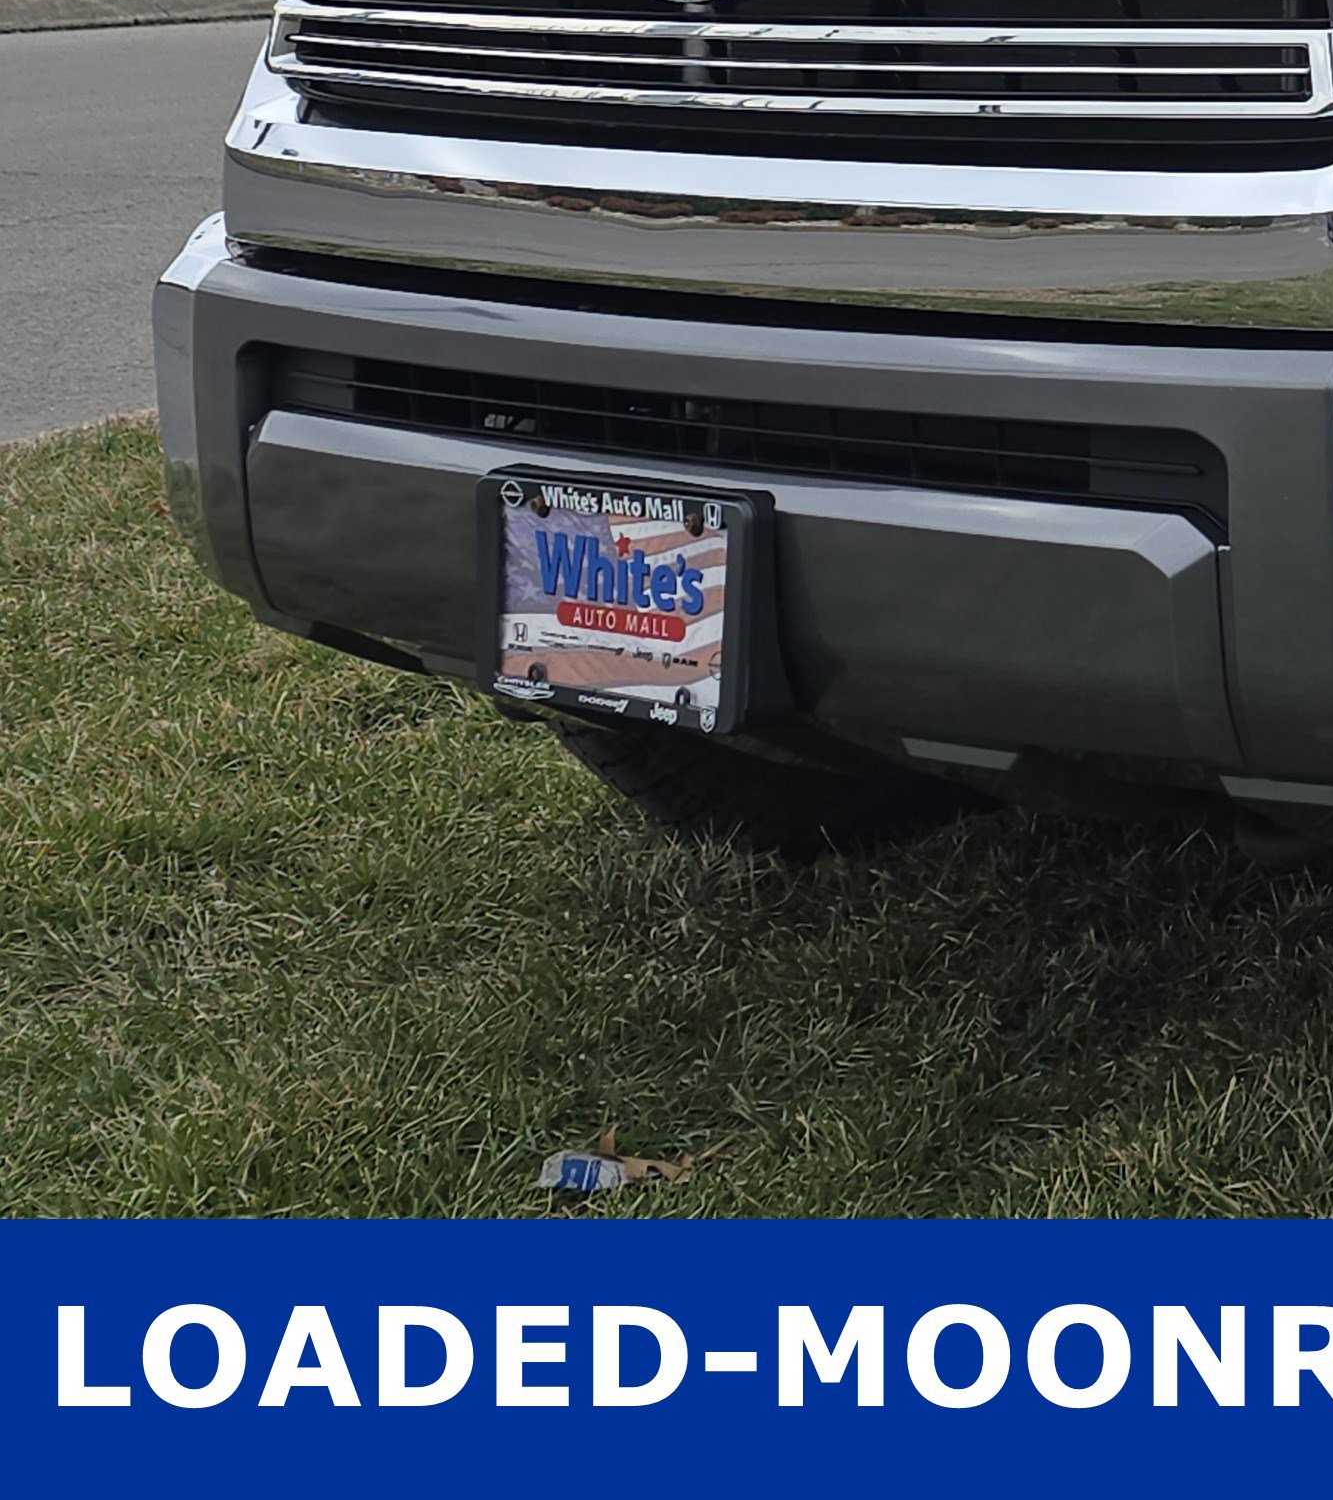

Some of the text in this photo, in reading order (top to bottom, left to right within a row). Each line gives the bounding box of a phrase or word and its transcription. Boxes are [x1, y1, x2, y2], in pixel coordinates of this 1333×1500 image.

[541, 485, 684, 522] White's Auto Mall
[535, 530, 705, 616] White's
[573, 607, 669, 638] AUTO MALL
[650, 702, 678, 726] Jeep
